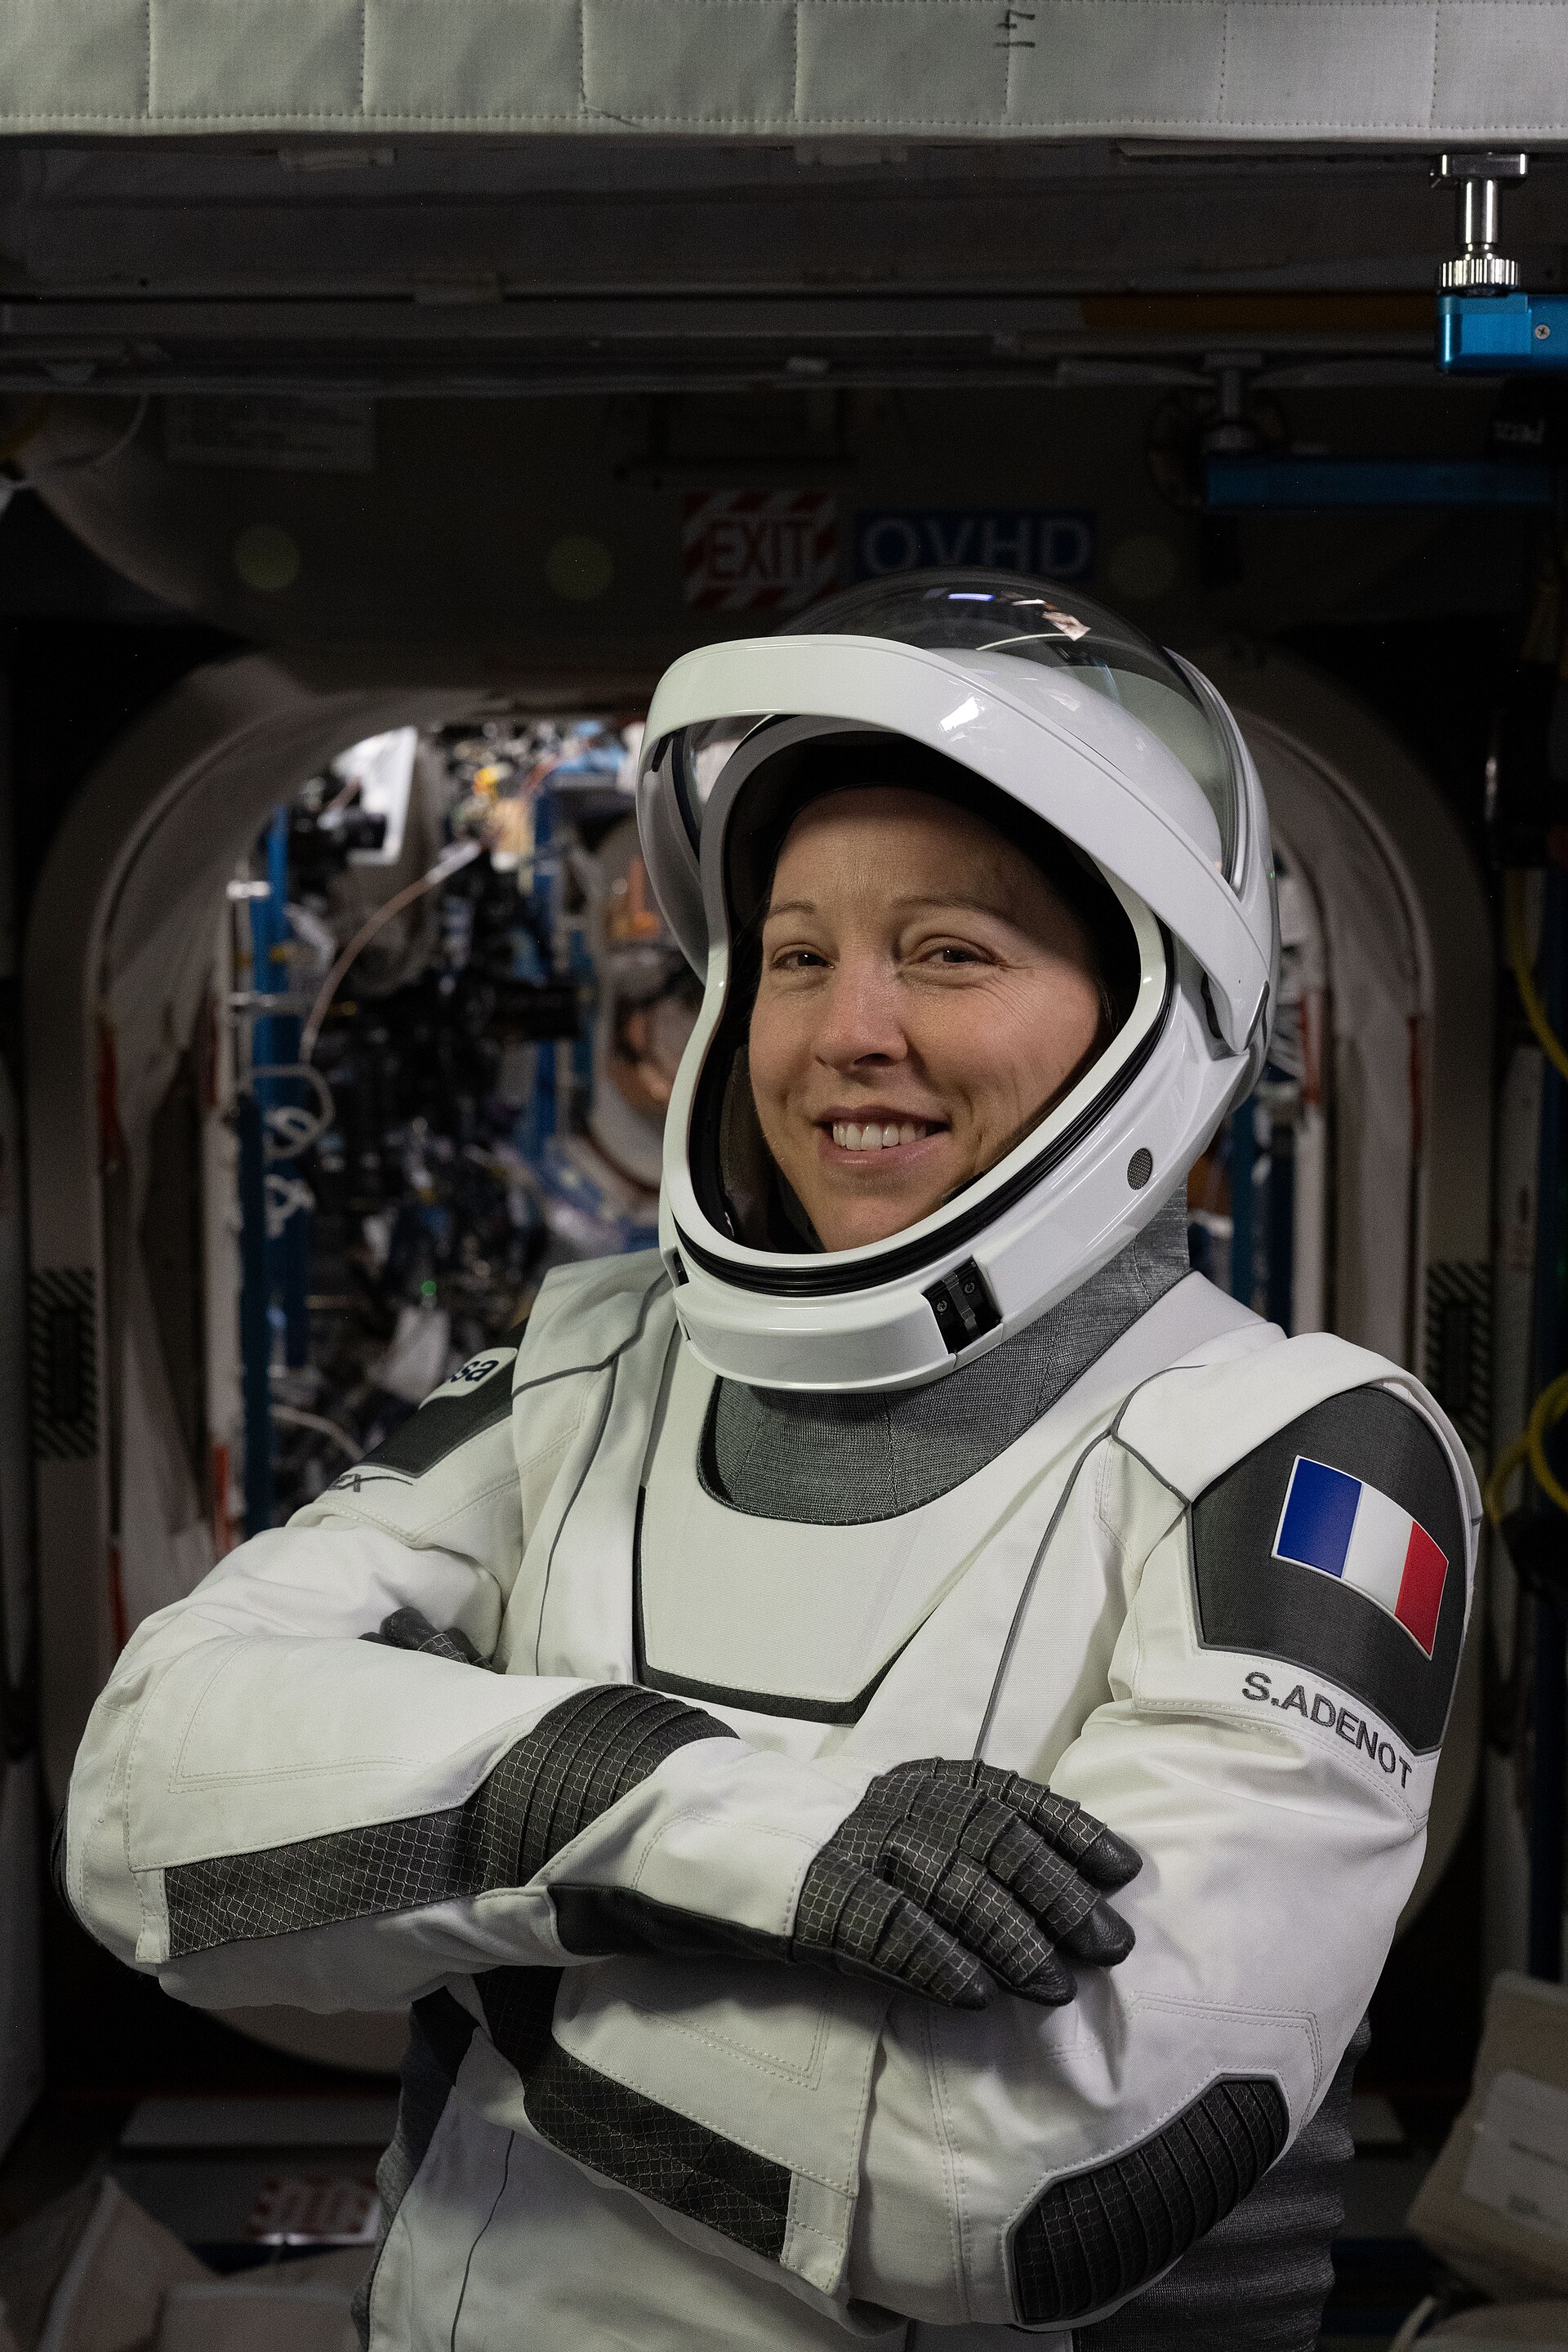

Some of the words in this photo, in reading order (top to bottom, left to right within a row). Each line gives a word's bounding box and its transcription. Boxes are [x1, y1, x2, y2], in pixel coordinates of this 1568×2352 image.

[707, 520, 813, 578] EXIT
[862, 516, 1092, 576] OVHD
[451, 1360, 500, 1383] sa
[1242, 1672, 1412, 1788] S.ADENOT
